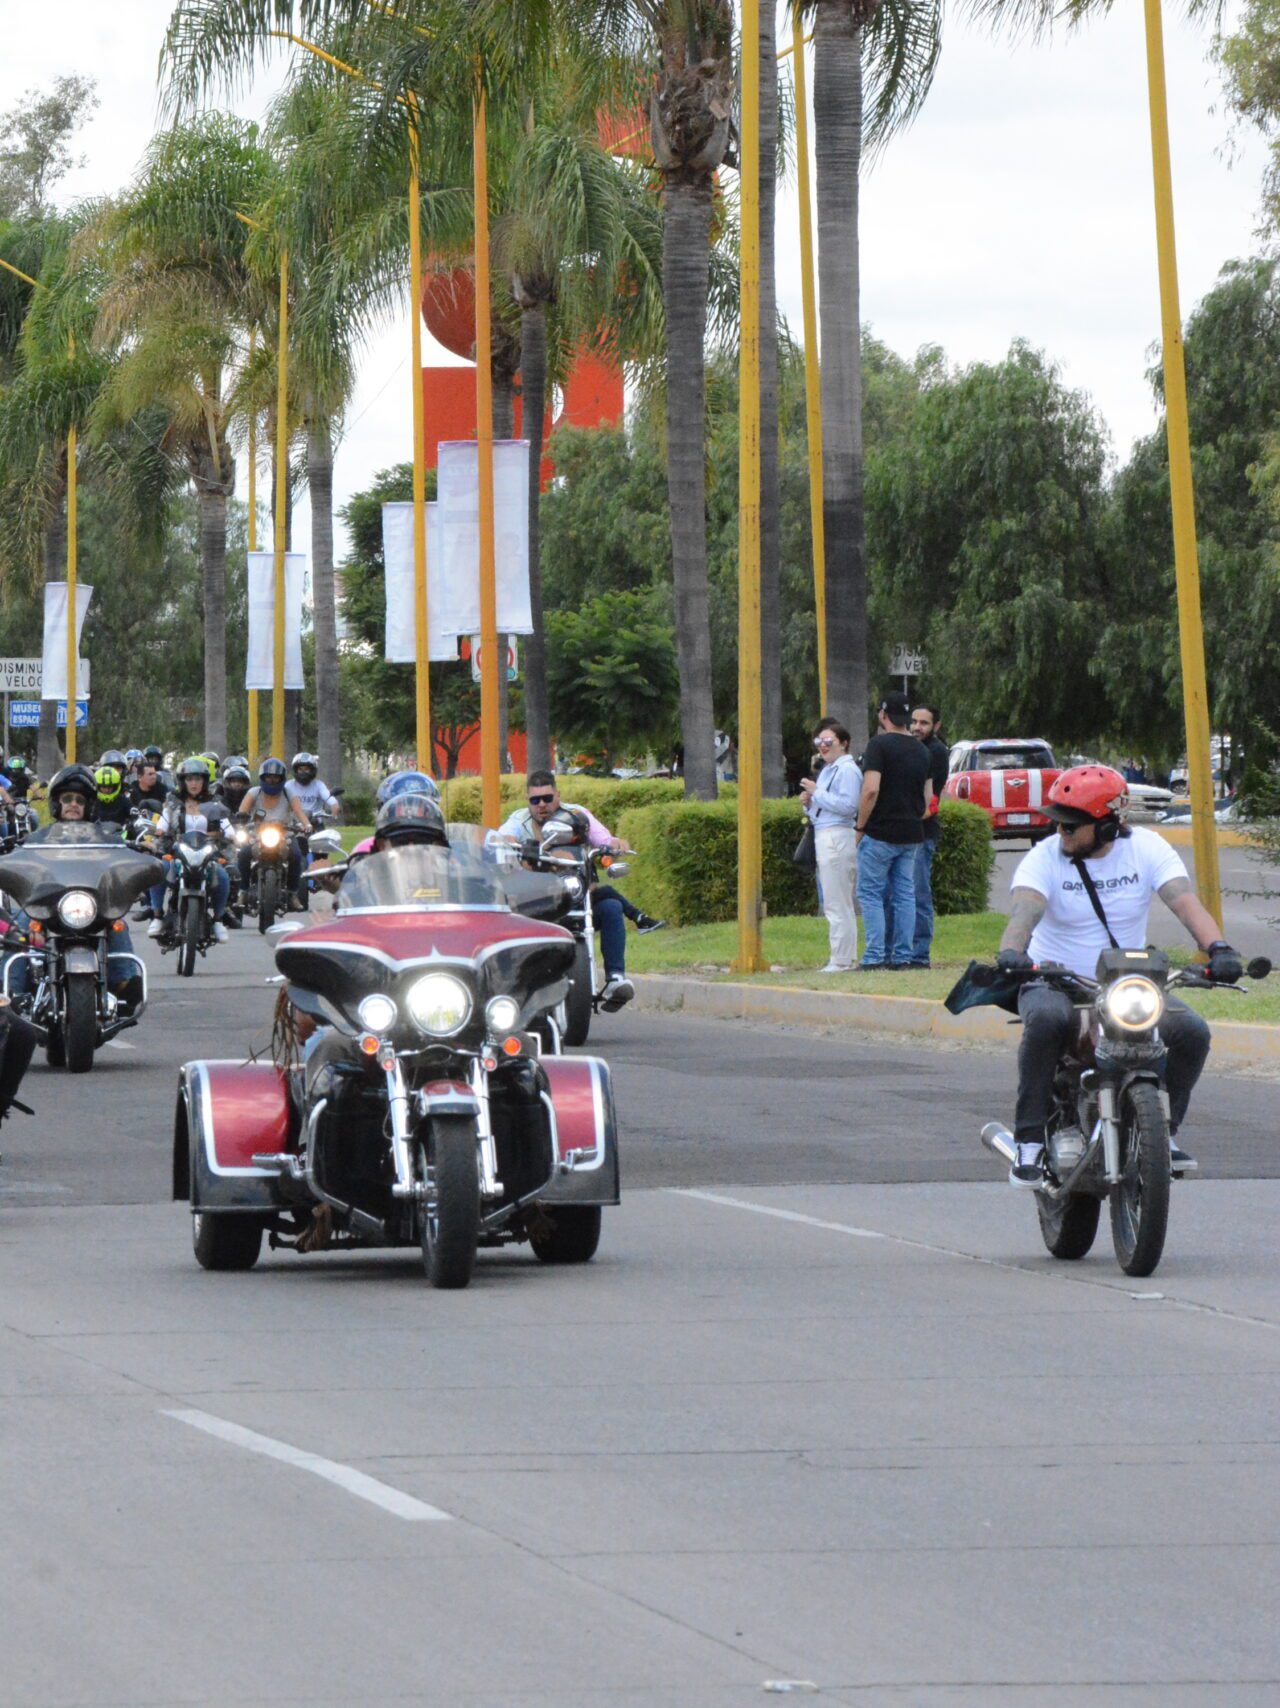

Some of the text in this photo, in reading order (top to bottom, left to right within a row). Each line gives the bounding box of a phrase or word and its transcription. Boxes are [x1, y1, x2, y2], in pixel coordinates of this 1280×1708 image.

[5, 675, 42, 687] VELOC
[12, 703, 41, 713] MUSE
[1062, 873, 1139, 891] GAS GYM
